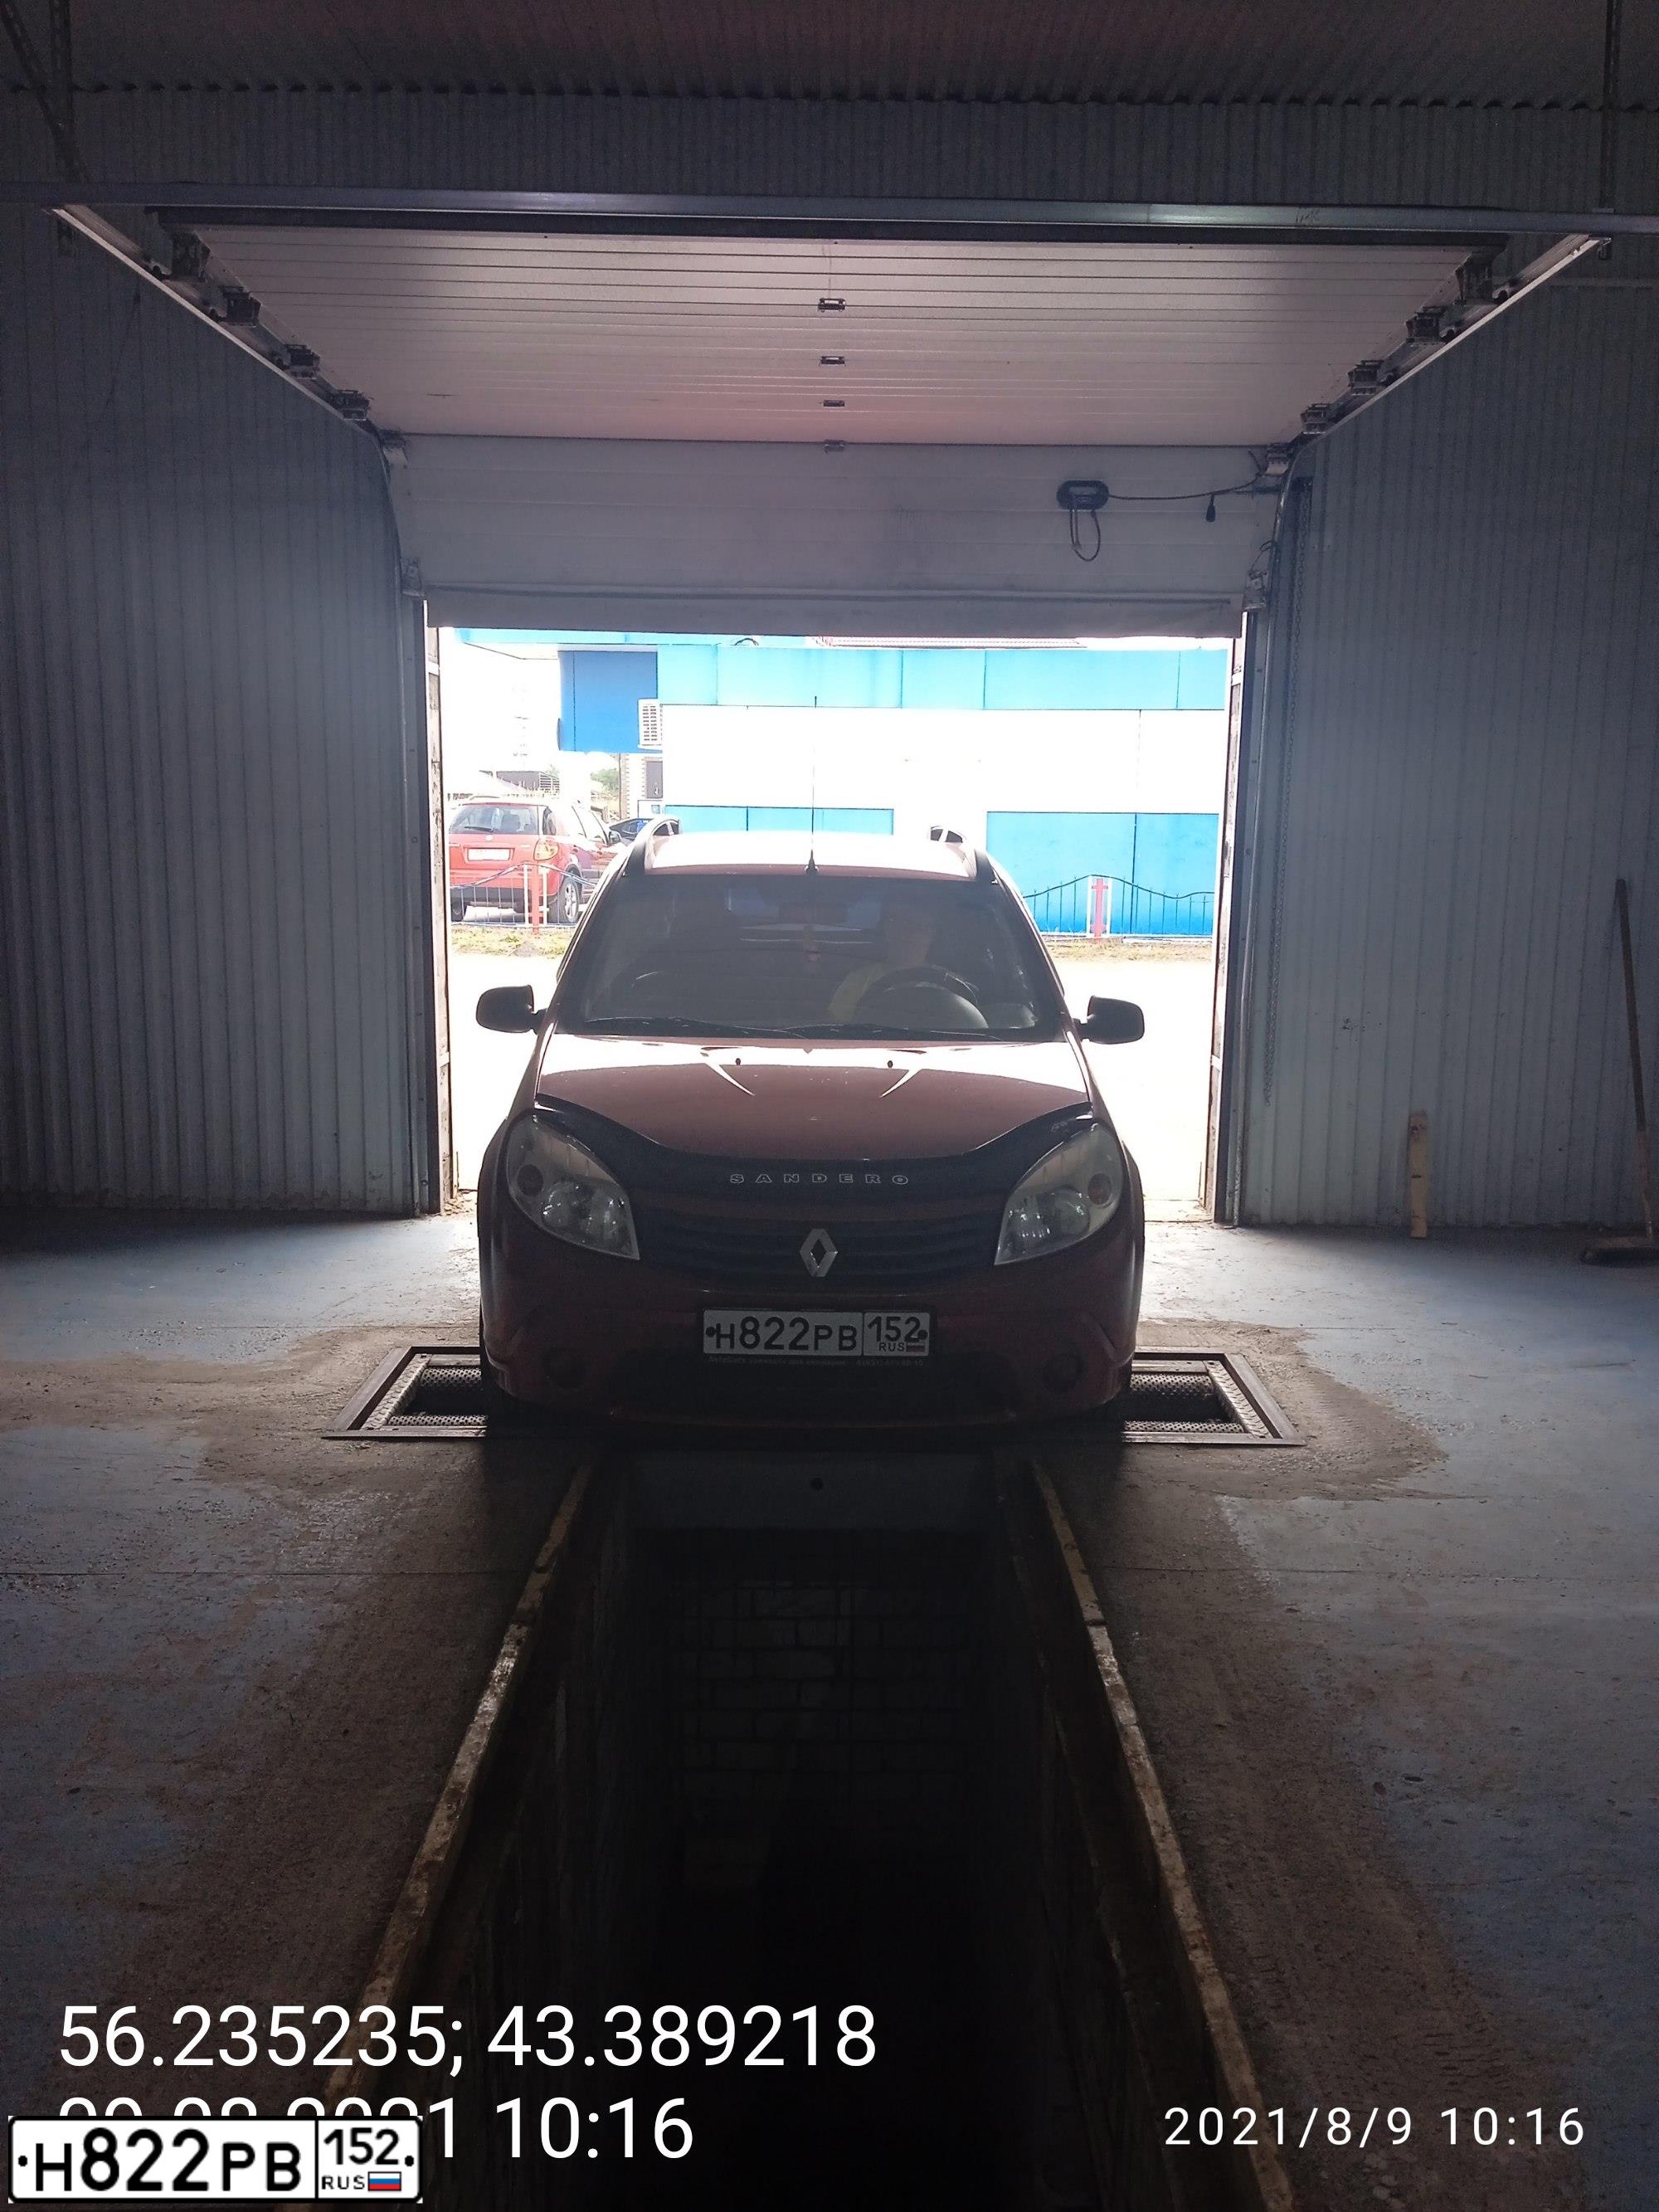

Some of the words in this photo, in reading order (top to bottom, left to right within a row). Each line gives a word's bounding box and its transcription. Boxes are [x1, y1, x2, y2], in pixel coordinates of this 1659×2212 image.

[730, 1174, 909, 1185] SANDERO
[868, 1316, 921, 1342] 152
[878, 1342, 905, 1352] RUS
